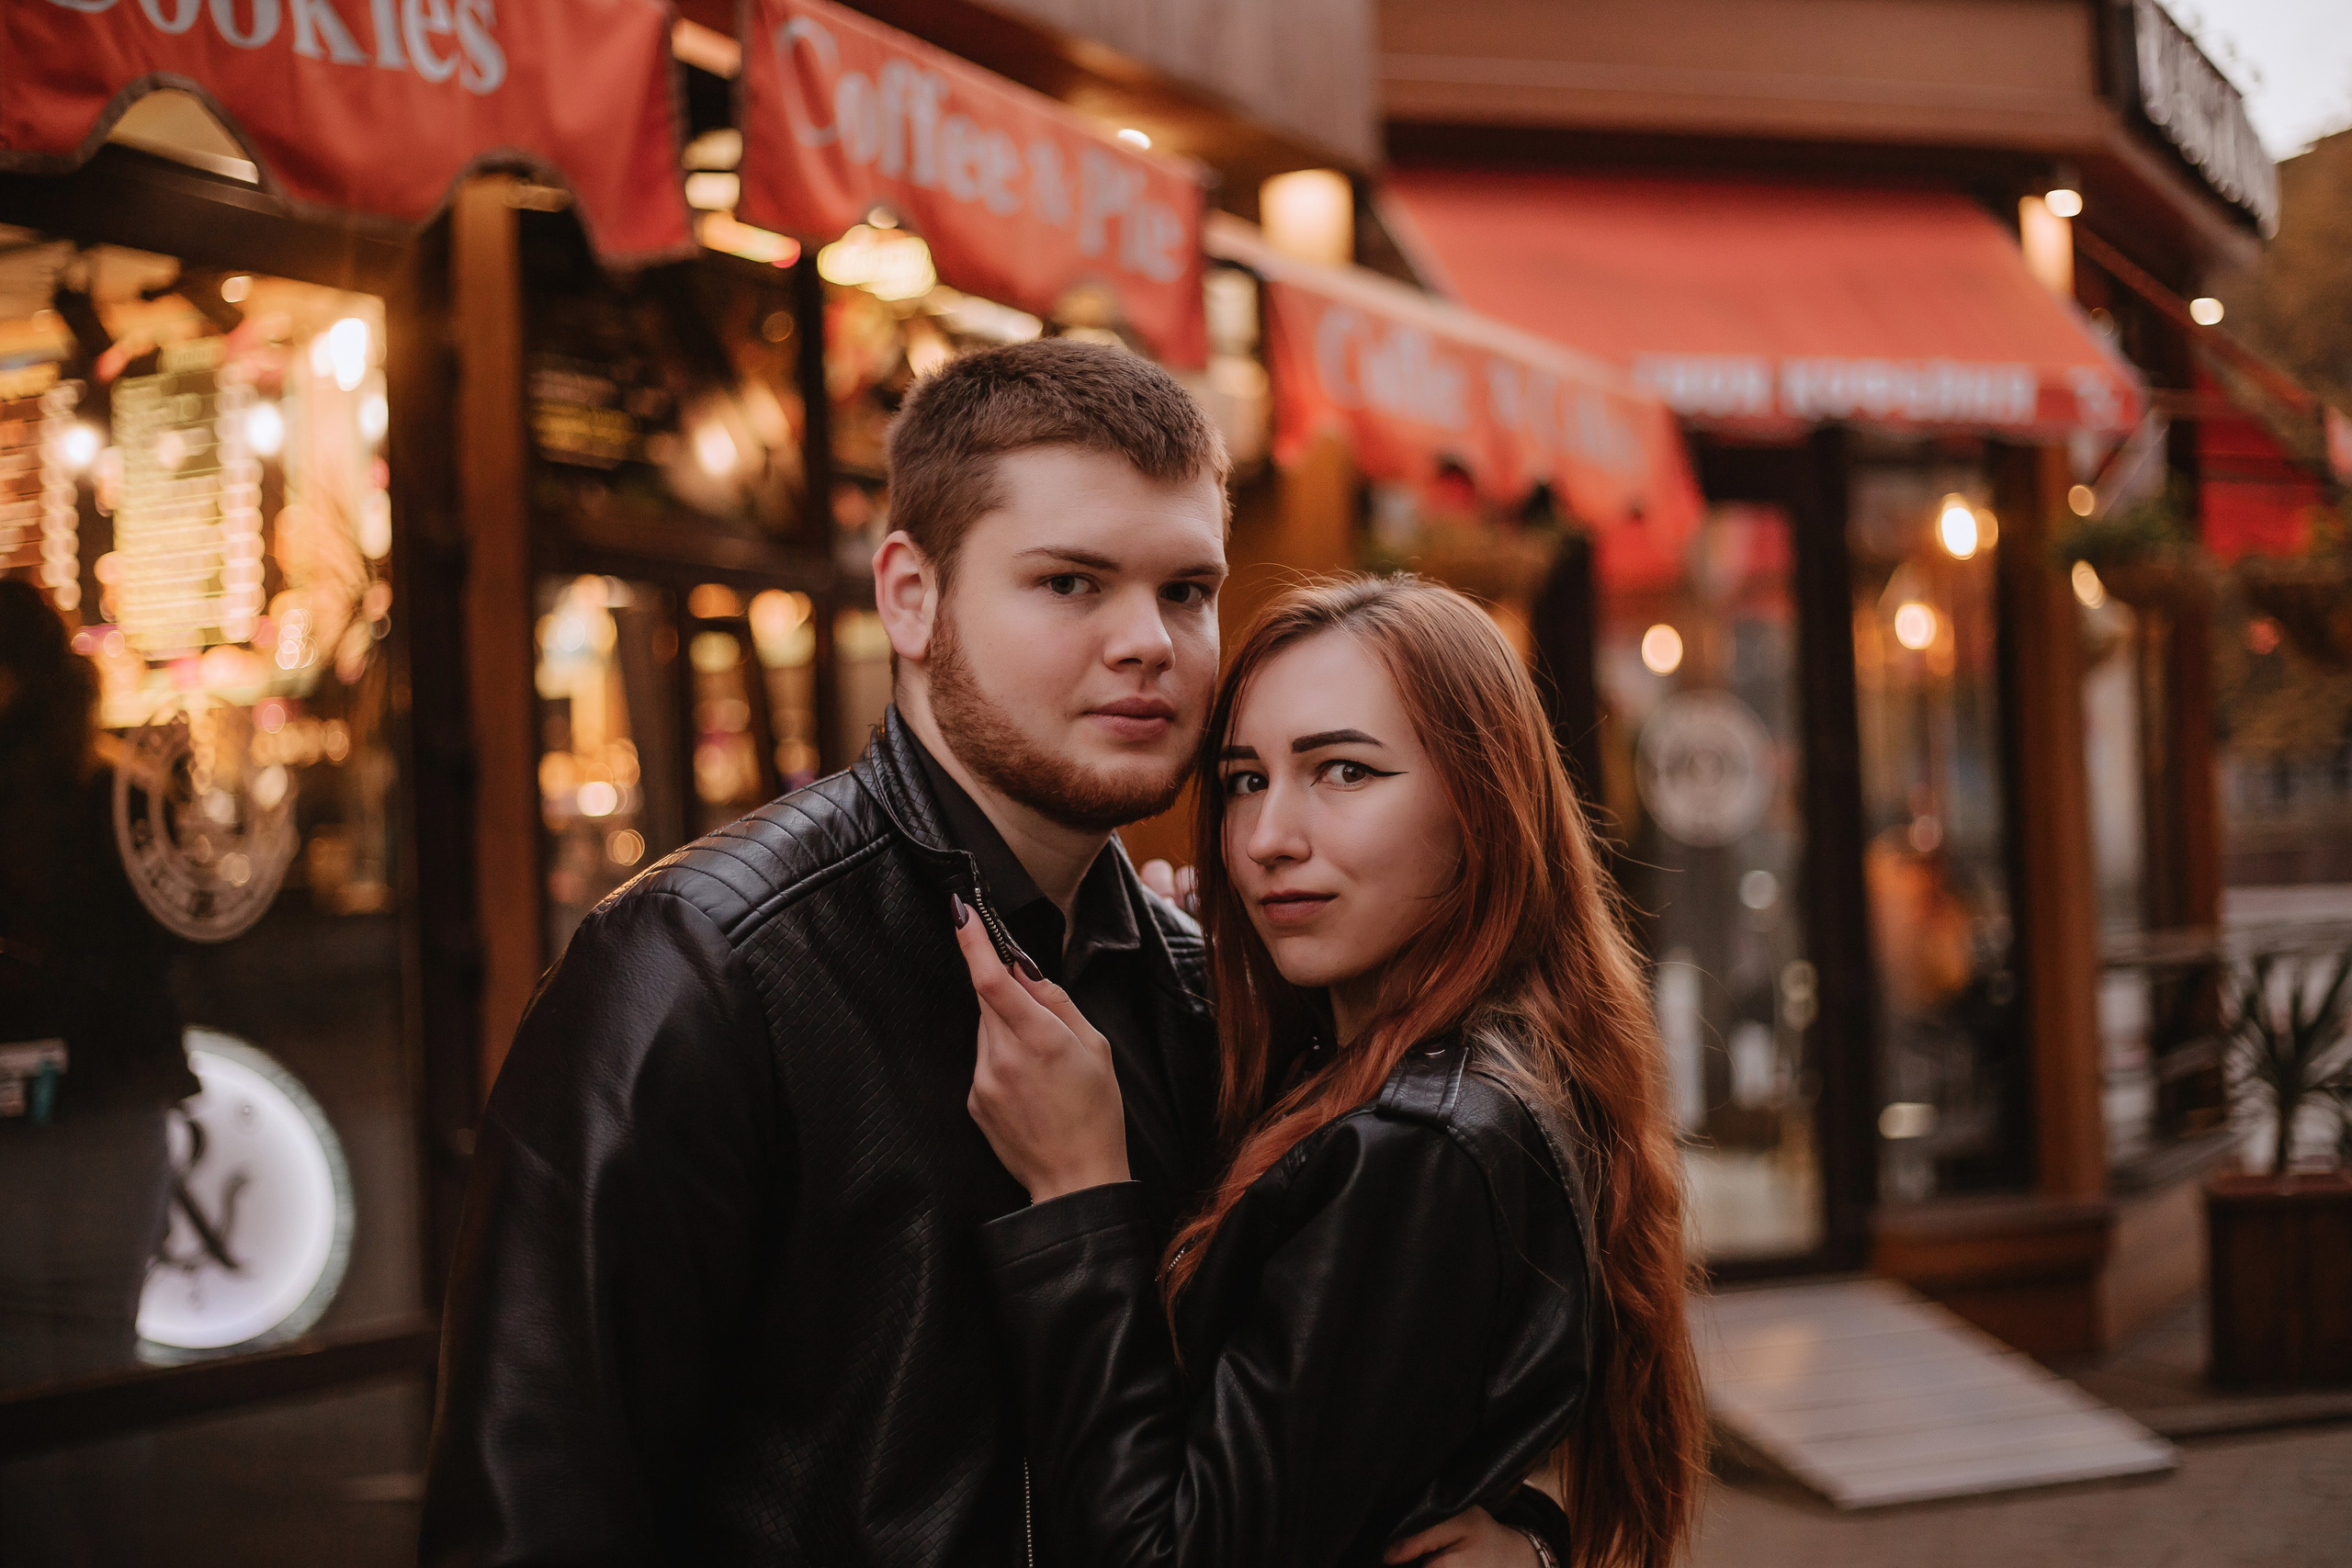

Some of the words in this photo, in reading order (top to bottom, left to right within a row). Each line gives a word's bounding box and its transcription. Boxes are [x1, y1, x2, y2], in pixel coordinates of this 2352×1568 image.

[46, 0, 507, 93] okies
[776, 15, 1023, 218] Coffee
[1078, 147, 1189, 284] Pie
